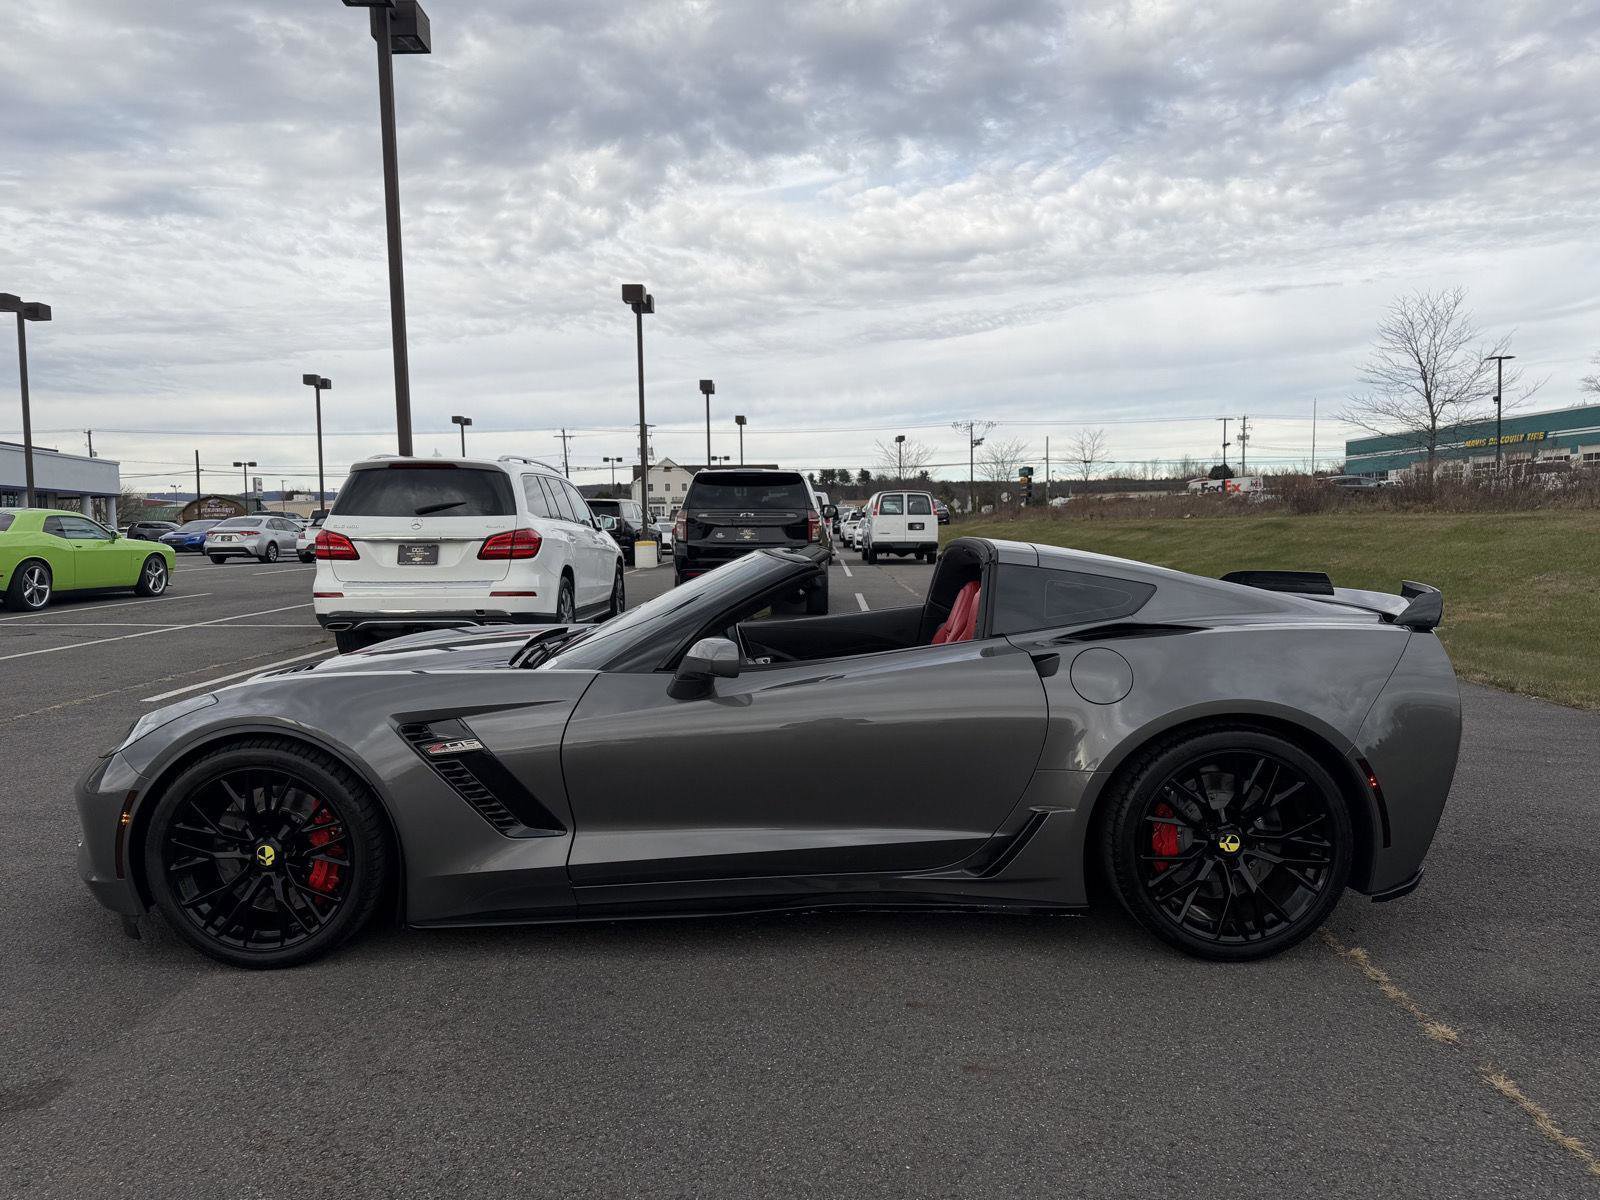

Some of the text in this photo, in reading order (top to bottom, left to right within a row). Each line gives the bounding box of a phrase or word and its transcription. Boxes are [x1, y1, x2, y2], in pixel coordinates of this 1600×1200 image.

[1488, 433, 1525, 445] DICOUNT
[1526, 431, 1545, 441] TIRE
[1200, 480, 1241, 493] FedEx
